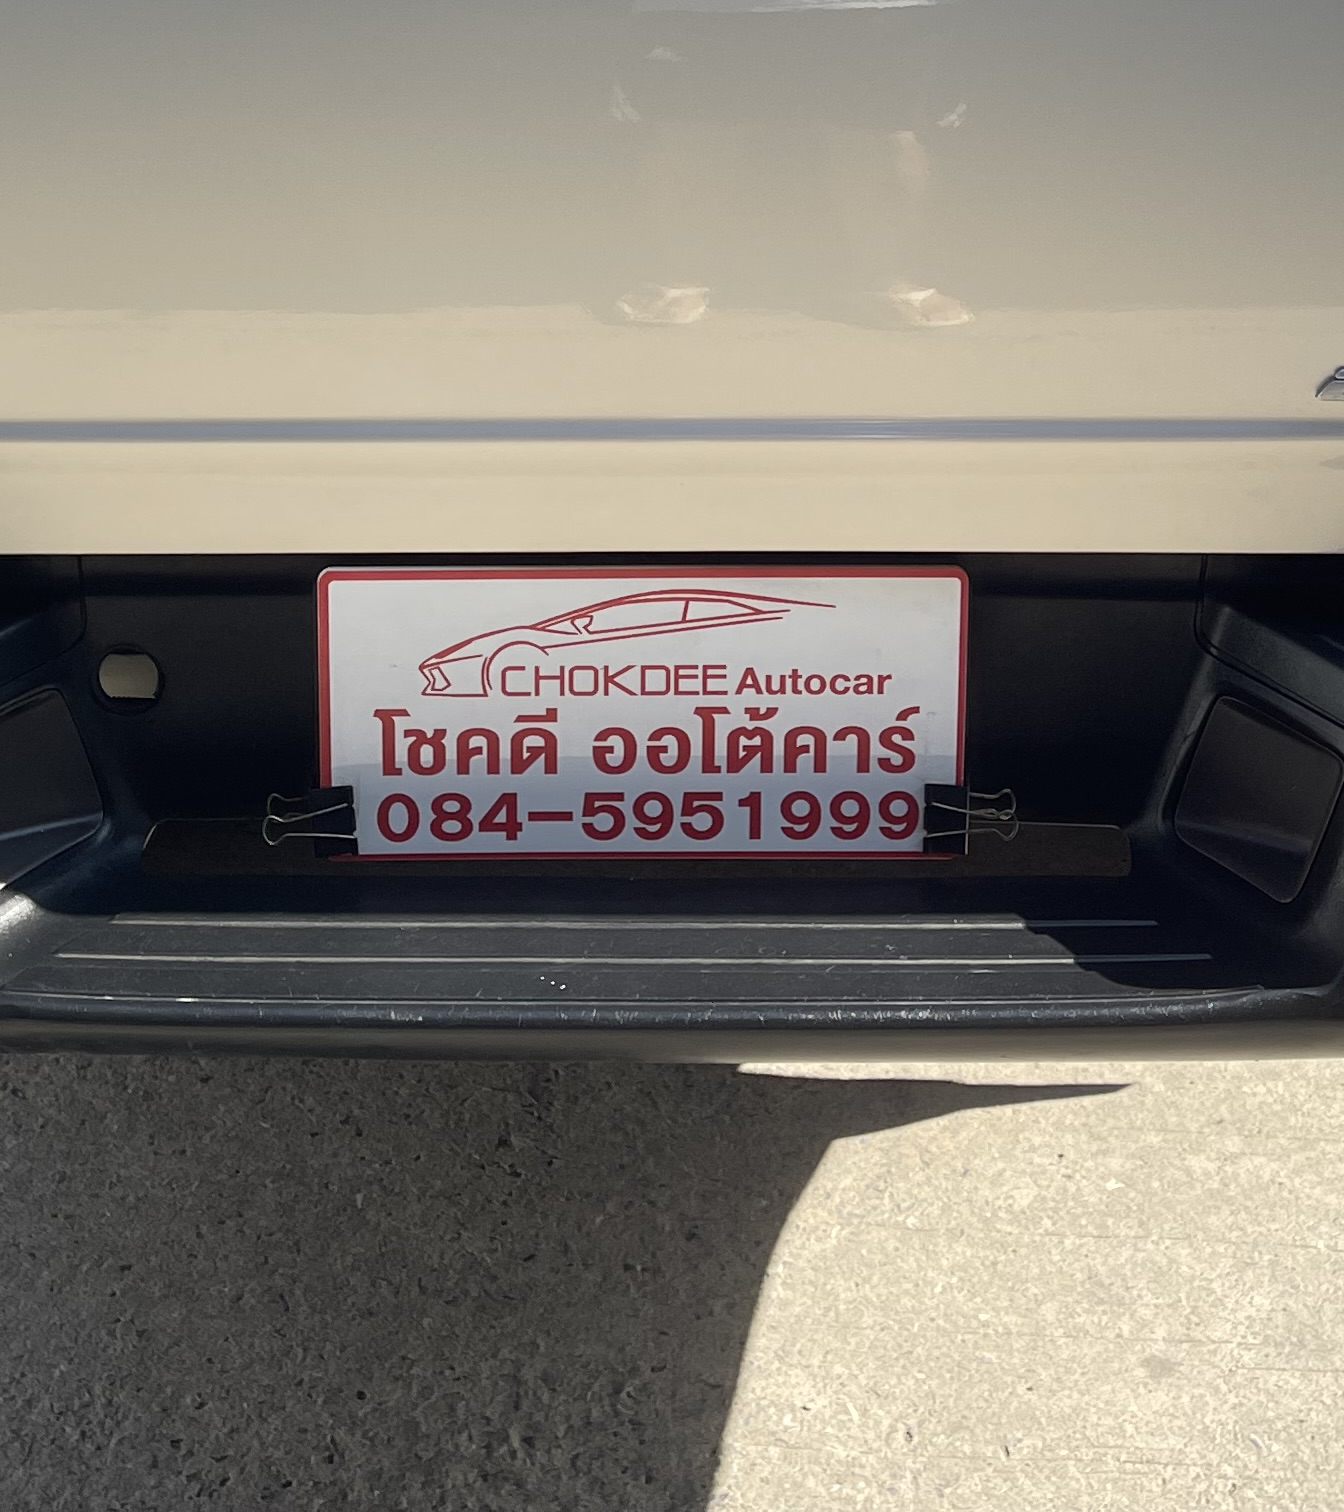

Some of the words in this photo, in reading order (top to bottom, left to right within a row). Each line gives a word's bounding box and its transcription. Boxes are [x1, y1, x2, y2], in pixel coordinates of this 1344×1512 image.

[499, 663, 729, 698] CHOKDEE
[734, 666, 893, 696] Autocar
[373, 706, 559, 777] โชคดี
[591, 705, 921, 776] ออโต้คาร์
[375, 790, 923, 843] 084-5951999
